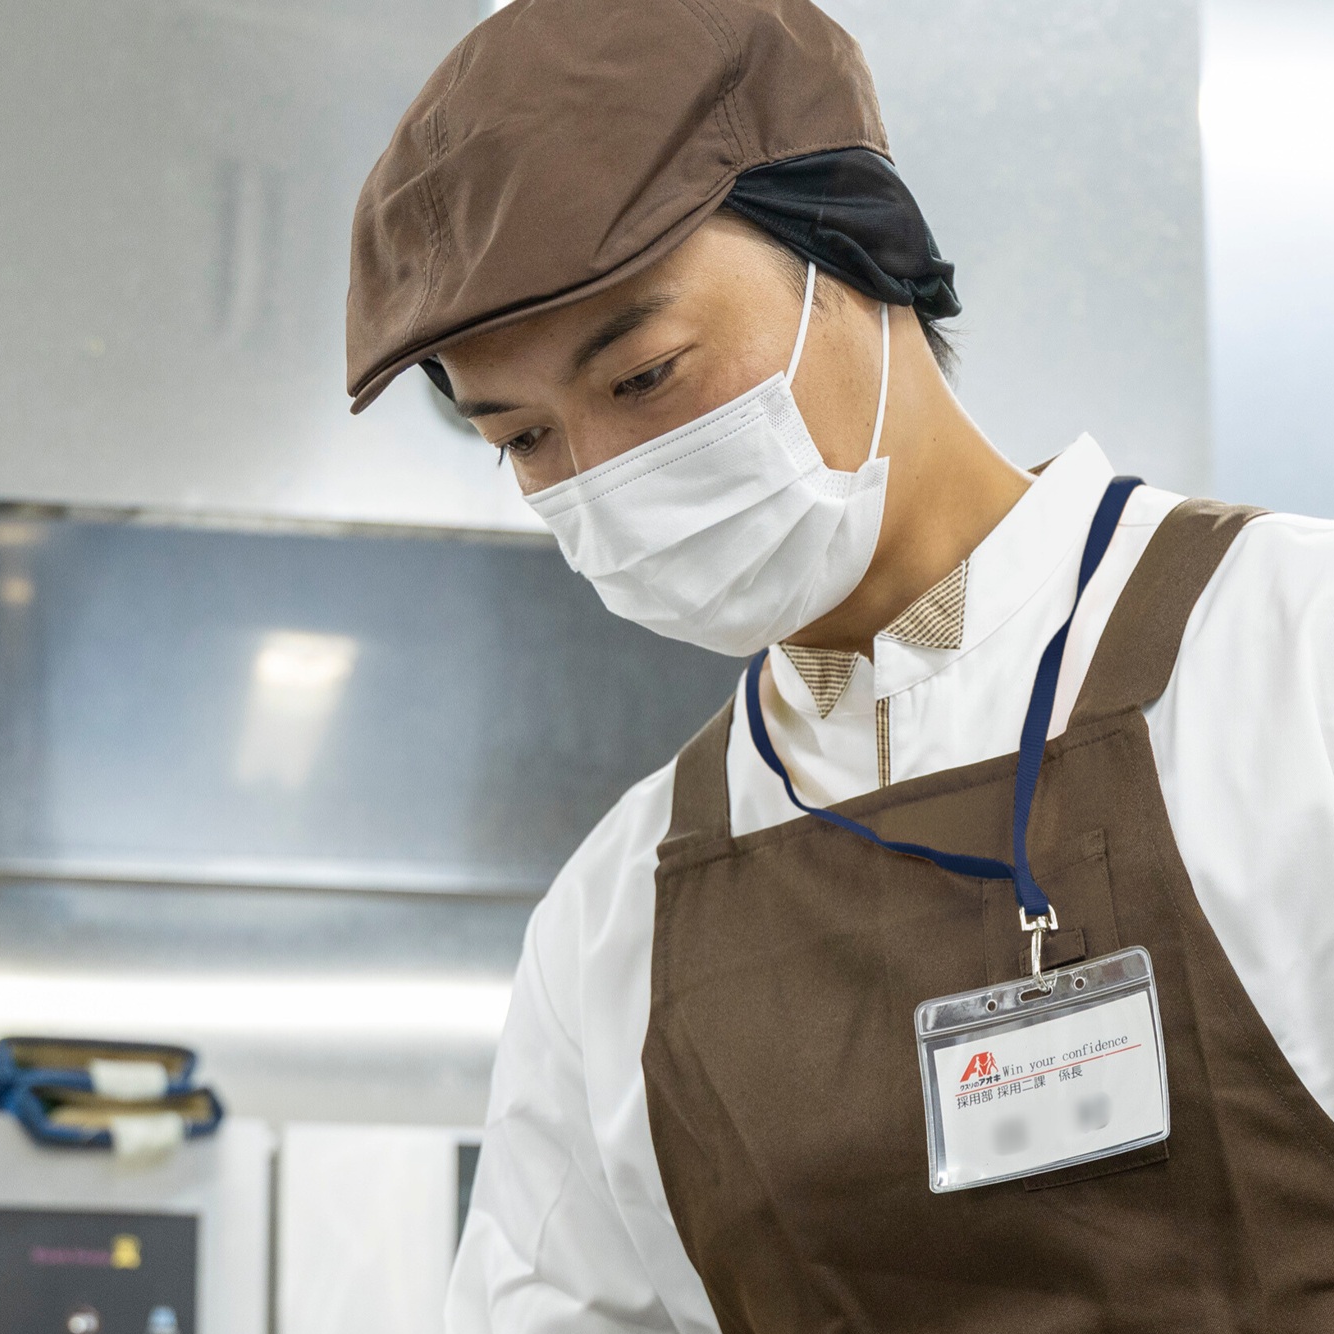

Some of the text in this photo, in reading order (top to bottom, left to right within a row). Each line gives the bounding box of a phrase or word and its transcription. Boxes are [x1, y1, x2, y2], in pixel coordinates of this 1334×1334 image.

[1002, 1035, 1128, 1077] Win your confidence
[956, 1065, 1083, 1110] 採用部 採用二課 係長
[959, 1074, 1001, 1092] クスリのアオキ
